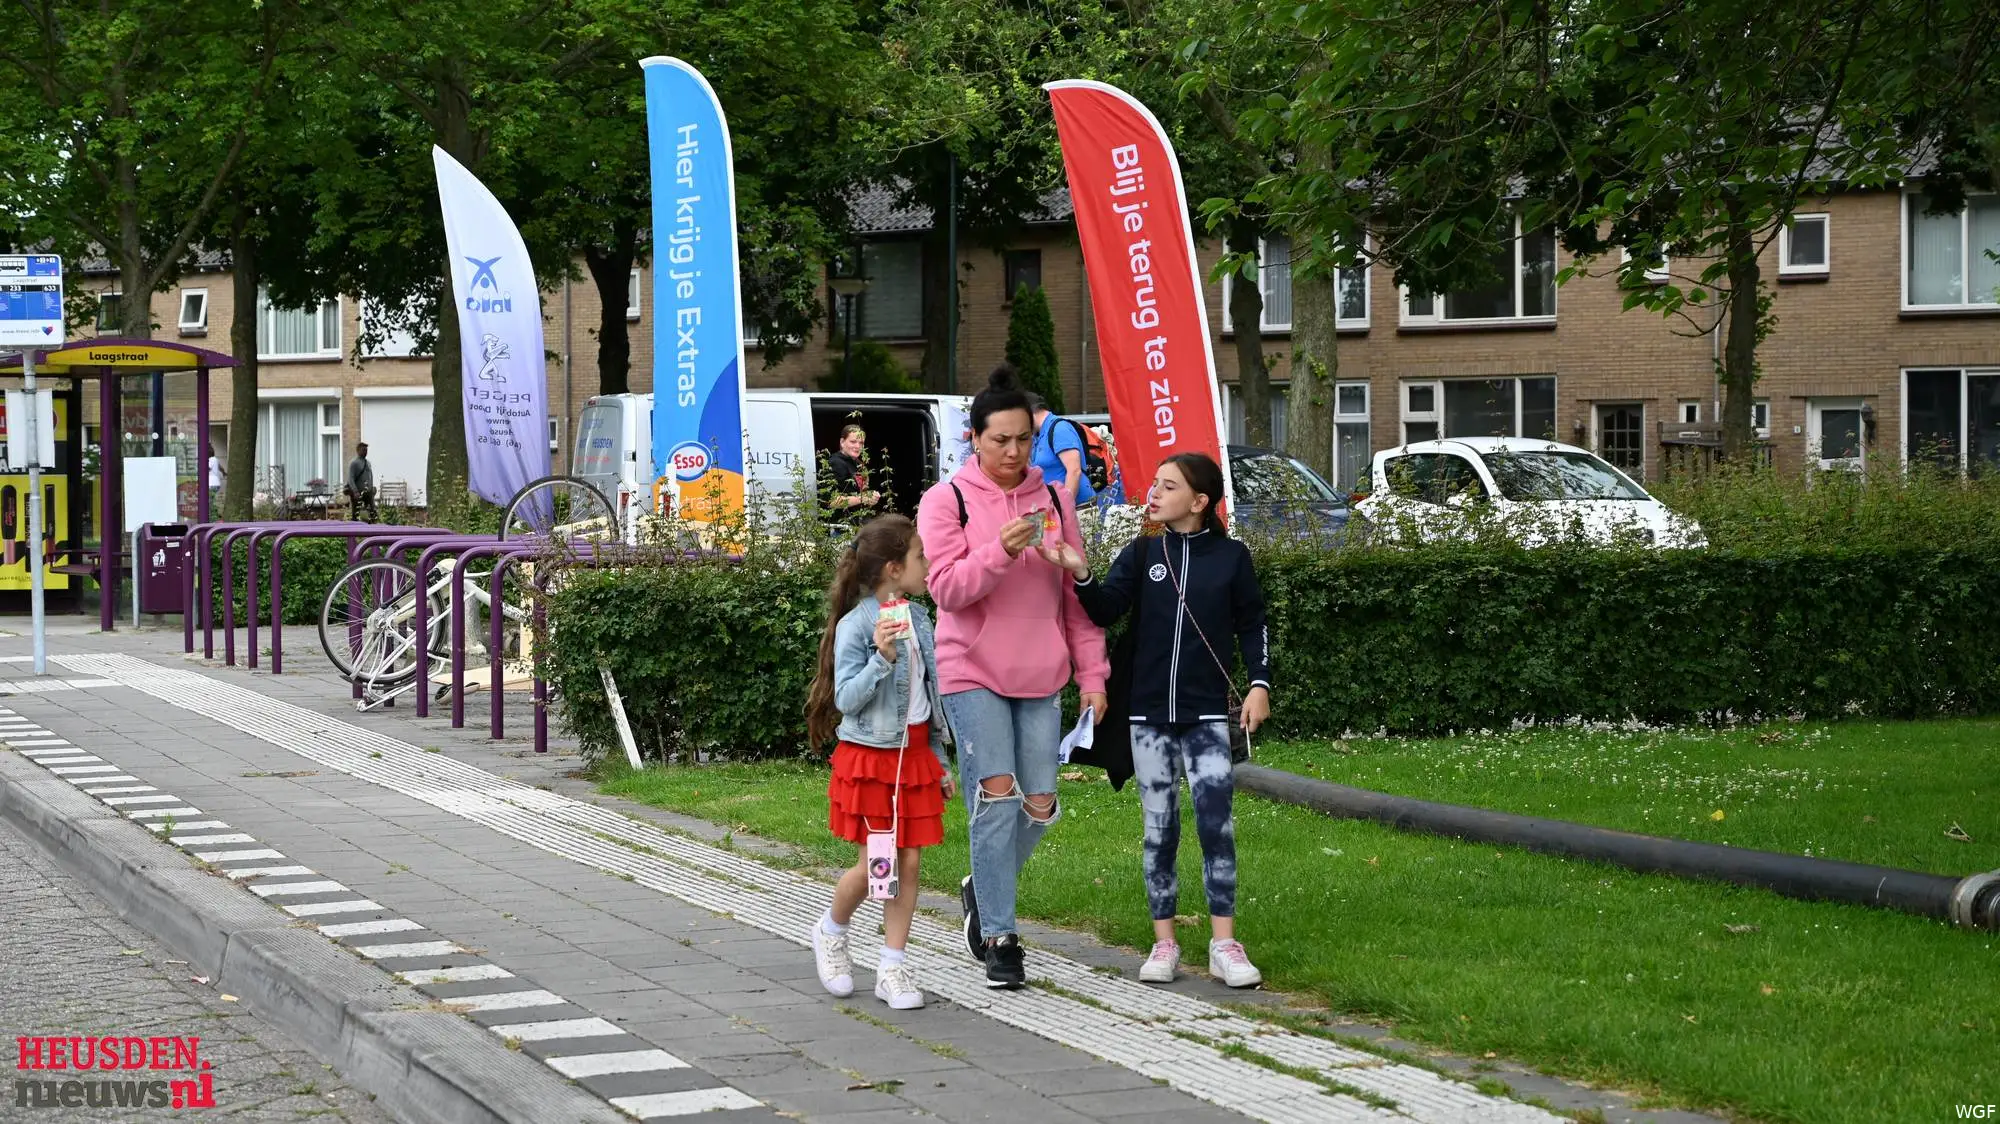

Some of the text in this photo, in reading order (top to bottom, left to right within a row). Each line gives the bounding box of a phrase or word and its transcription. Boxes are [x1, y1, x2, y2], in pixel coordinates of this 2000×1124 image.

[669, 123, 702, 408] Hier krijg je Extras
[1109, 143, 1180, 448] Blij je terug te zien
[89, 351, 148, 363] Laagstraat
[674, 453, 704, 469] Esso
